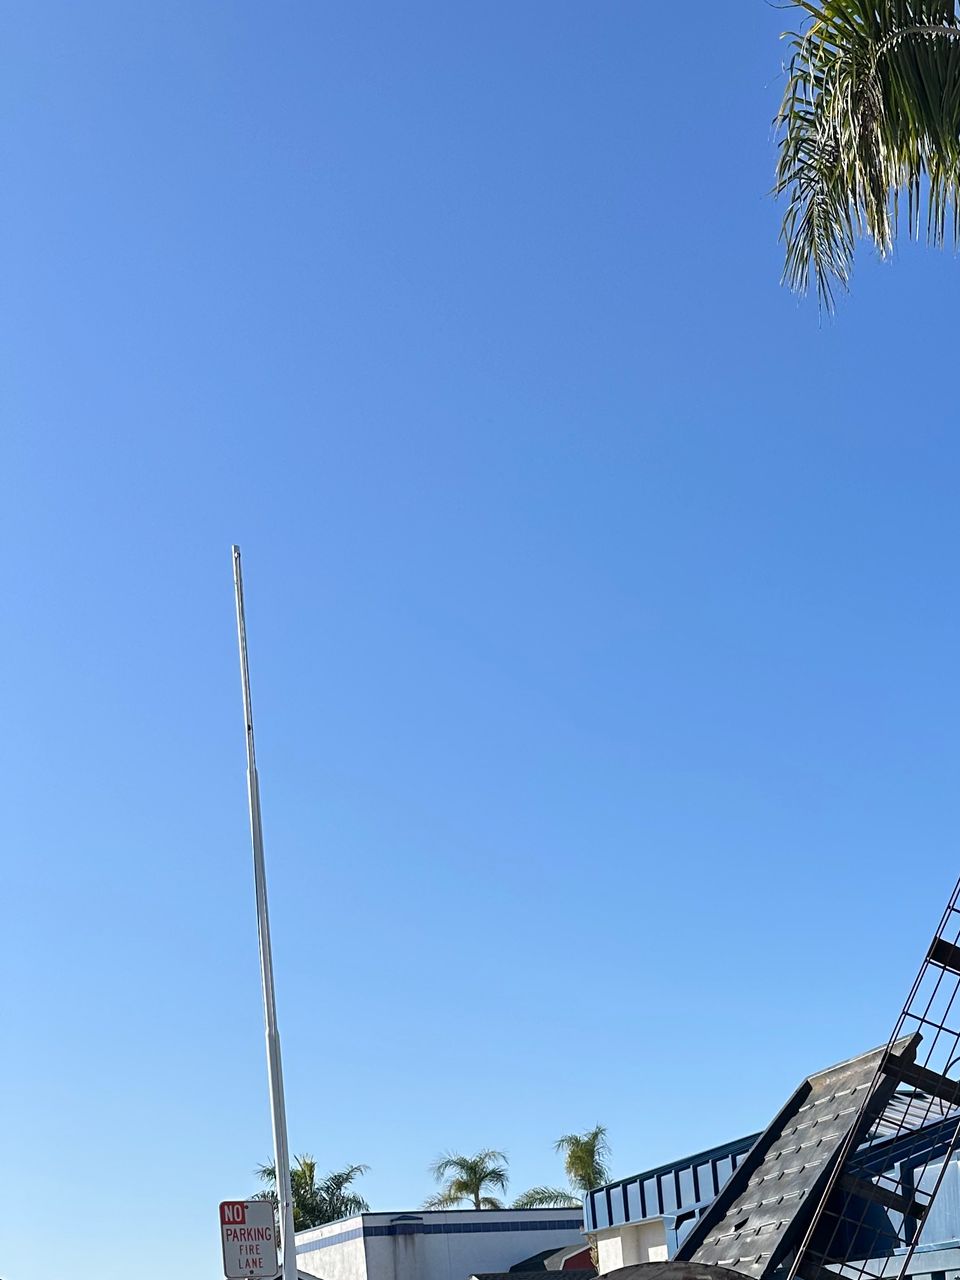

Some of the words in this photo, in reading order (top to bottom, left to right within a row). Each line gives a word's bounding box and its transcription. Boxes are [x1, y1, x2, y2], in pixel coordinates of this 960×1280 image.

[224, 1205, 242, 1222] NO
[226, 1227, 271, 1242] PARKING
[239, 1244, 260, 1255] FIRE
[238, 1258, 264, 1269] LANE
